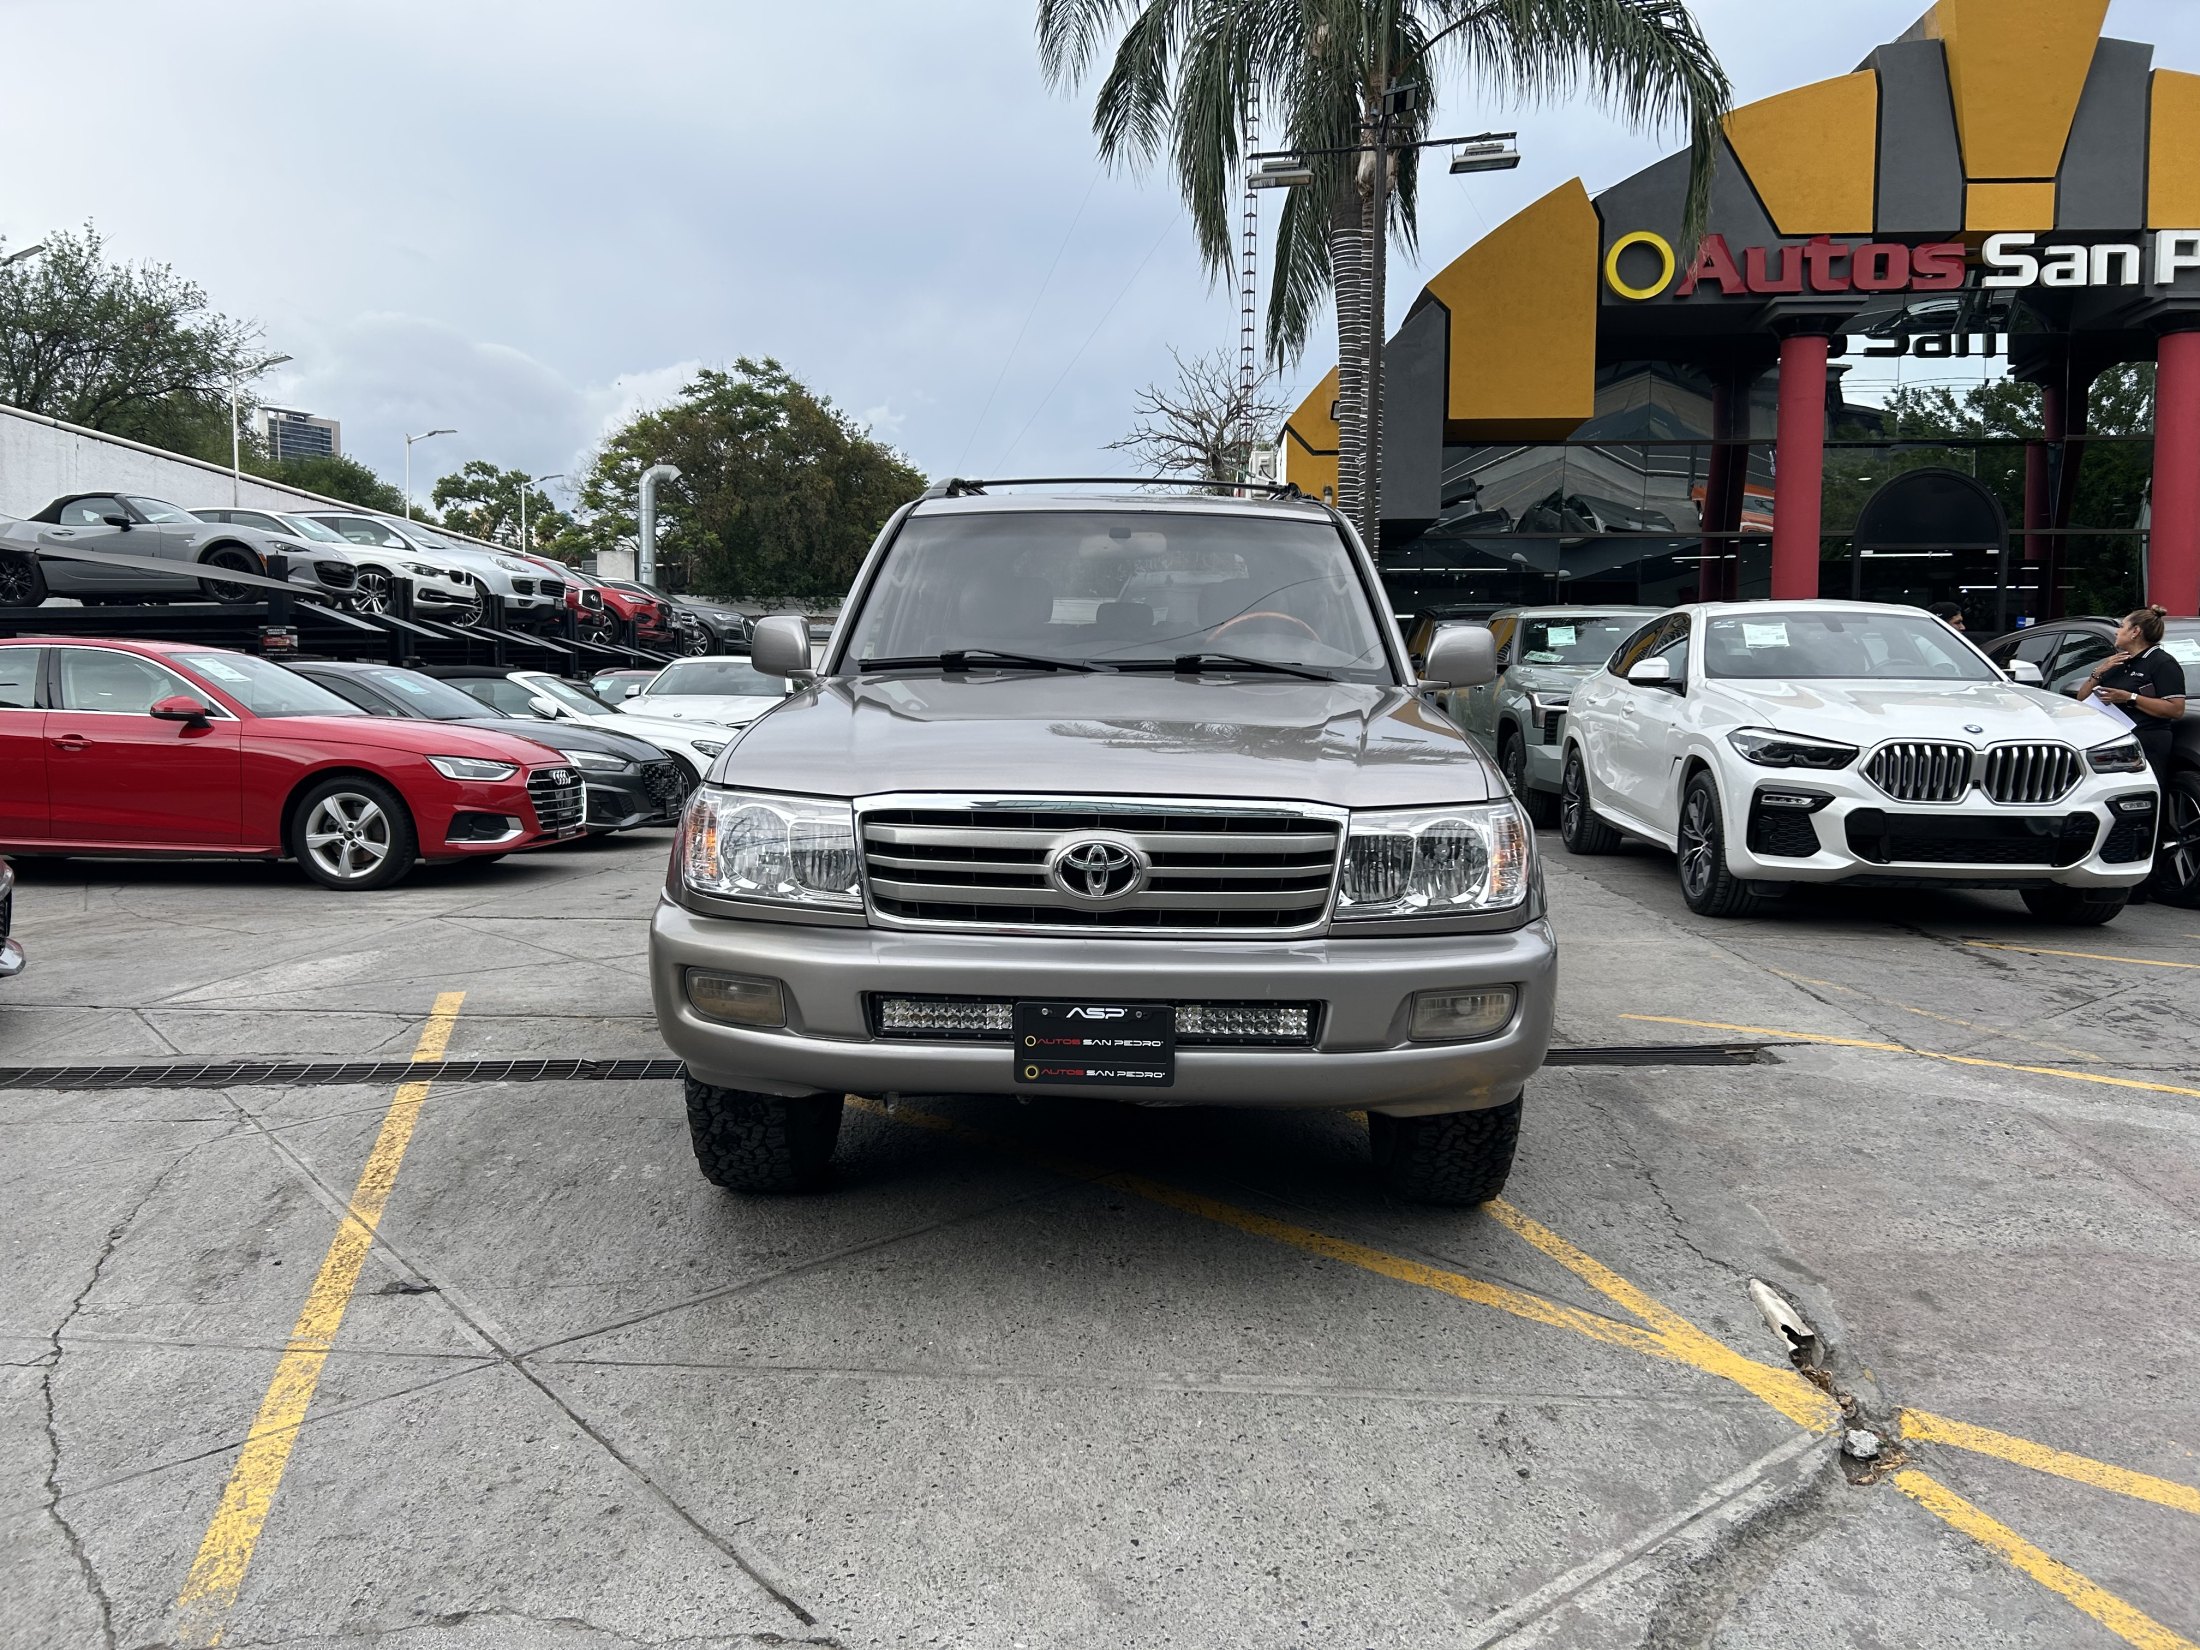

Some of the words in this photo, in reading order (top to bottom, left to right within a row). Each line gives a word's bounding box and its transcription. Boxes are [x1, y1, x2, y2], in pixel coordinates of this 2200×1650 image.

[1674, 232, 1967, 297] Autos
[1981, 232, 2140, 289] San
[1065, 1006, 1126, 1020] ASP
[1037, 1038, 1081, 1046] AUTOS
[1114, 1039, 1162, 1047] PEDRO
[1041, 1068, 1085, 1076] AUTOS
[1086, 1069, 1115, 1077] SAN
[1117, 1070, 1164, 1079] PEDRO
